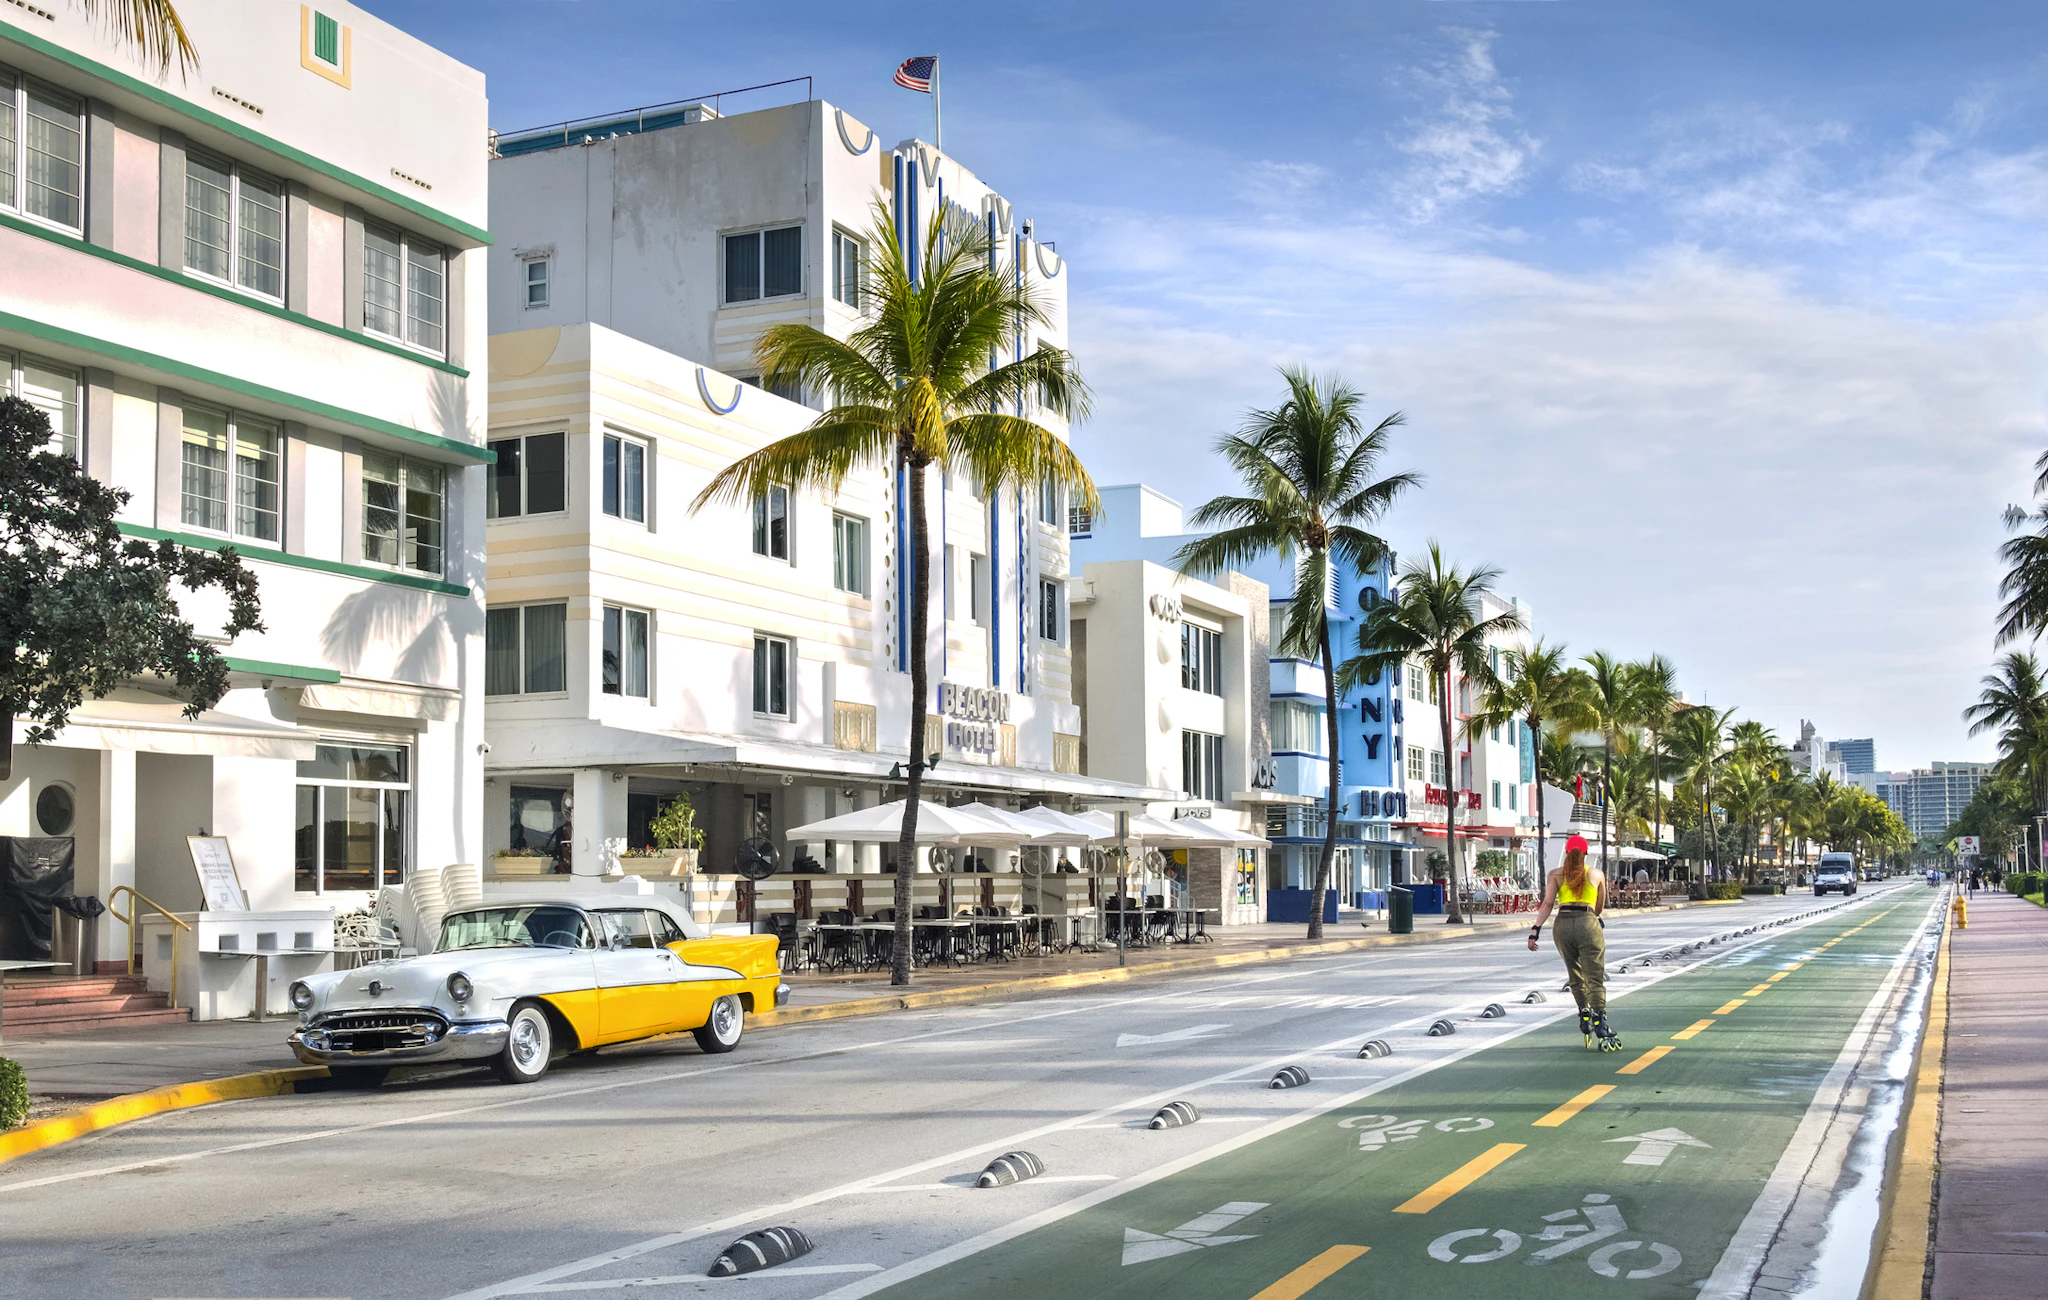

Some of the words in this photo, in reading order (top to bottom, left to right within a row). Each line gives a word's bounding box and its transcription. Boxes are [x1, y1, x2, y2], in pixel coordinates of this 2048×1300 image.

[1164, 598, 1184, 620] CVS
[941, 683, 1010, 722] BEACON
[949, 722, 998, 751] HOTEL
[1258, 759, 1278, 787] CVS
[1188, 808, 1210, 818] CVS
